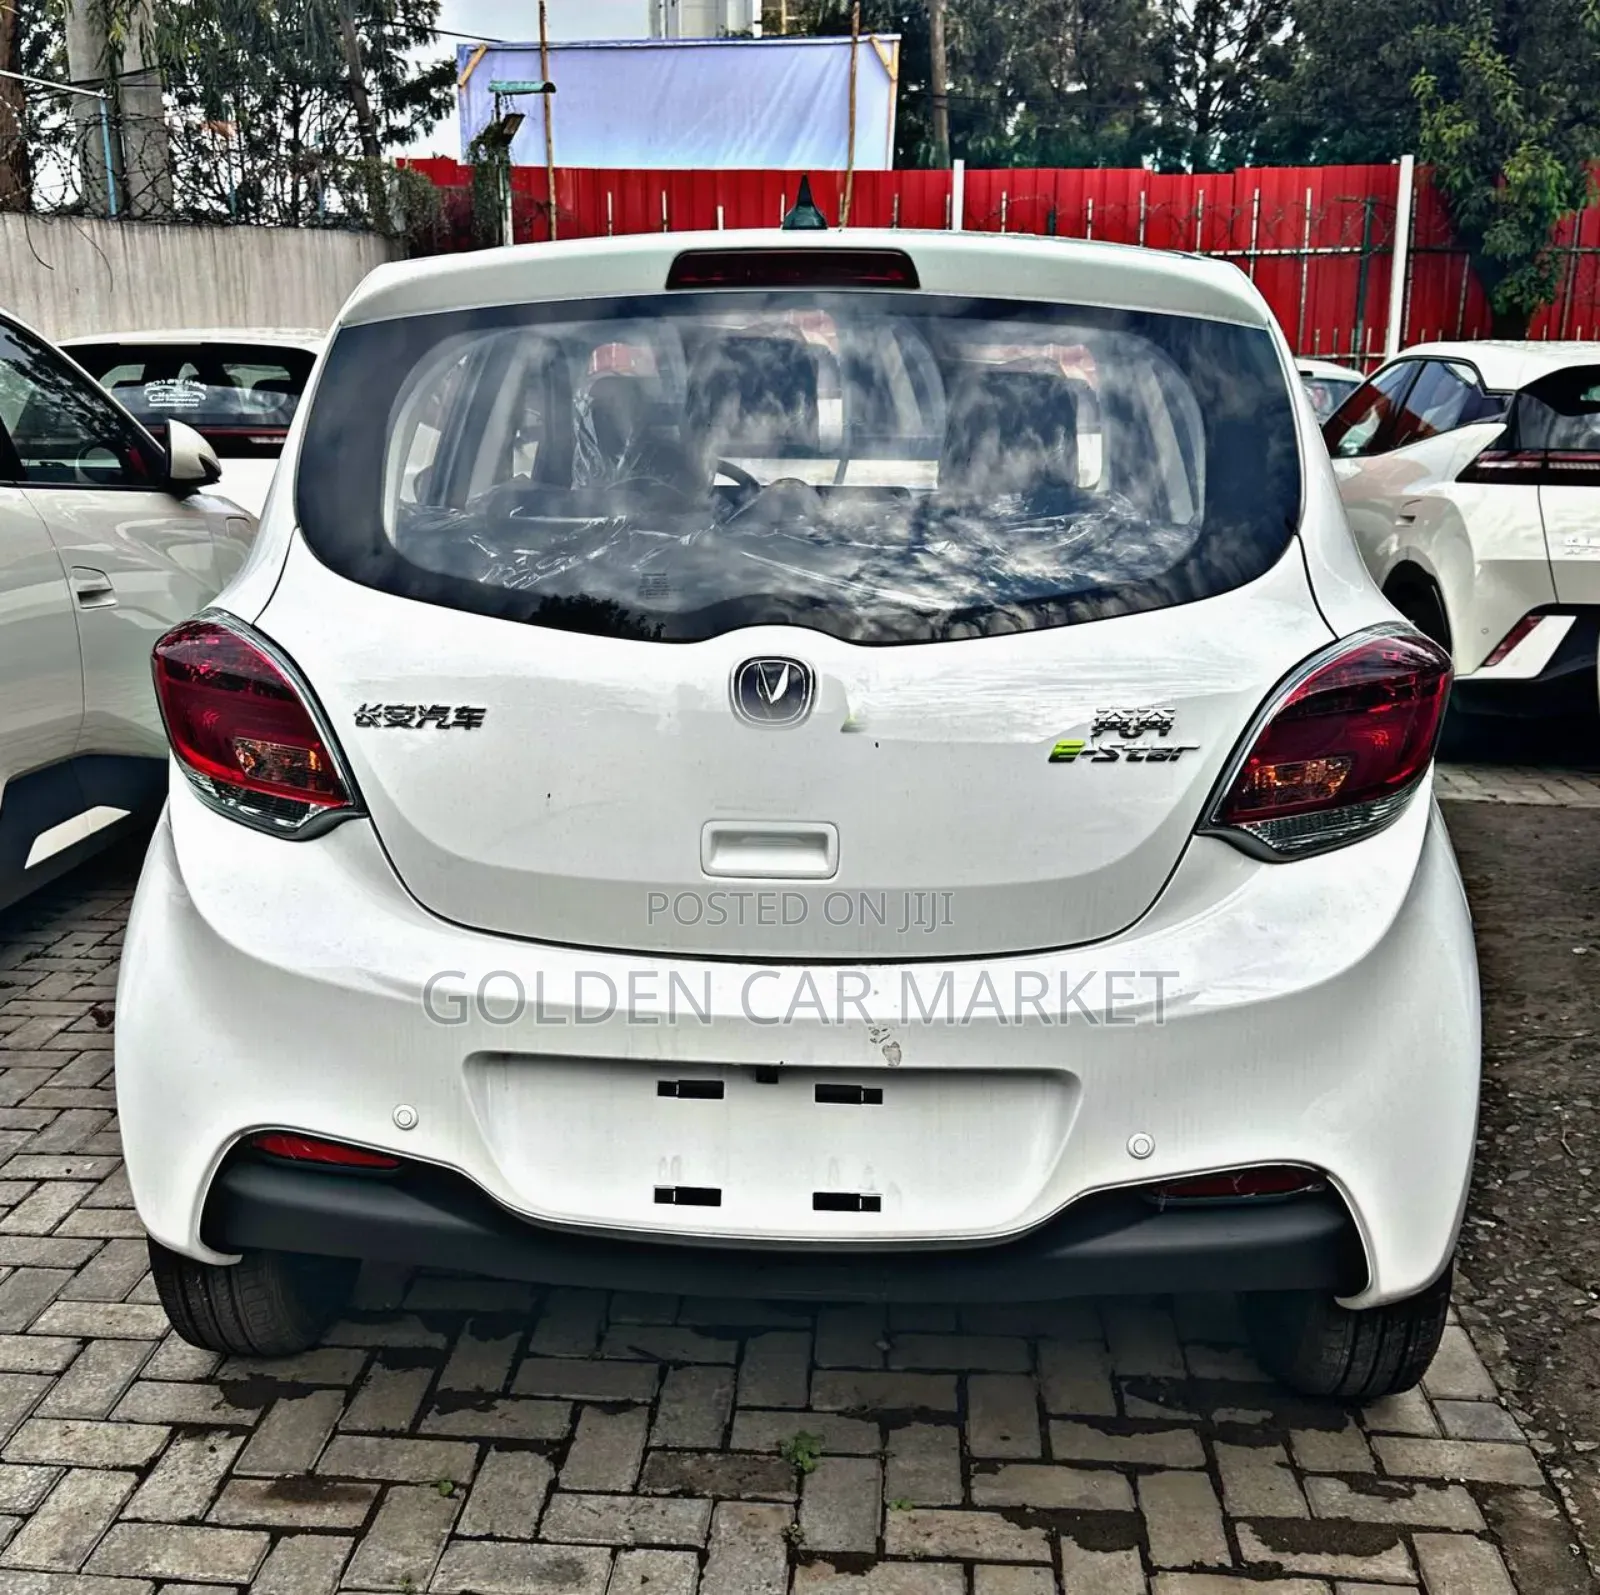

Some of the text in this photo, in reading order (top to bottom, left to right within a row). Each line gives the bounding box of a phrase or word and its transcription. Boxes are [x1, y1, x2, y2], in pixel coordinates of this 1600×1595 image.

[353, 703, 487, 730] 长安汽车
[1048, 739, 1201, 763] E-Star
